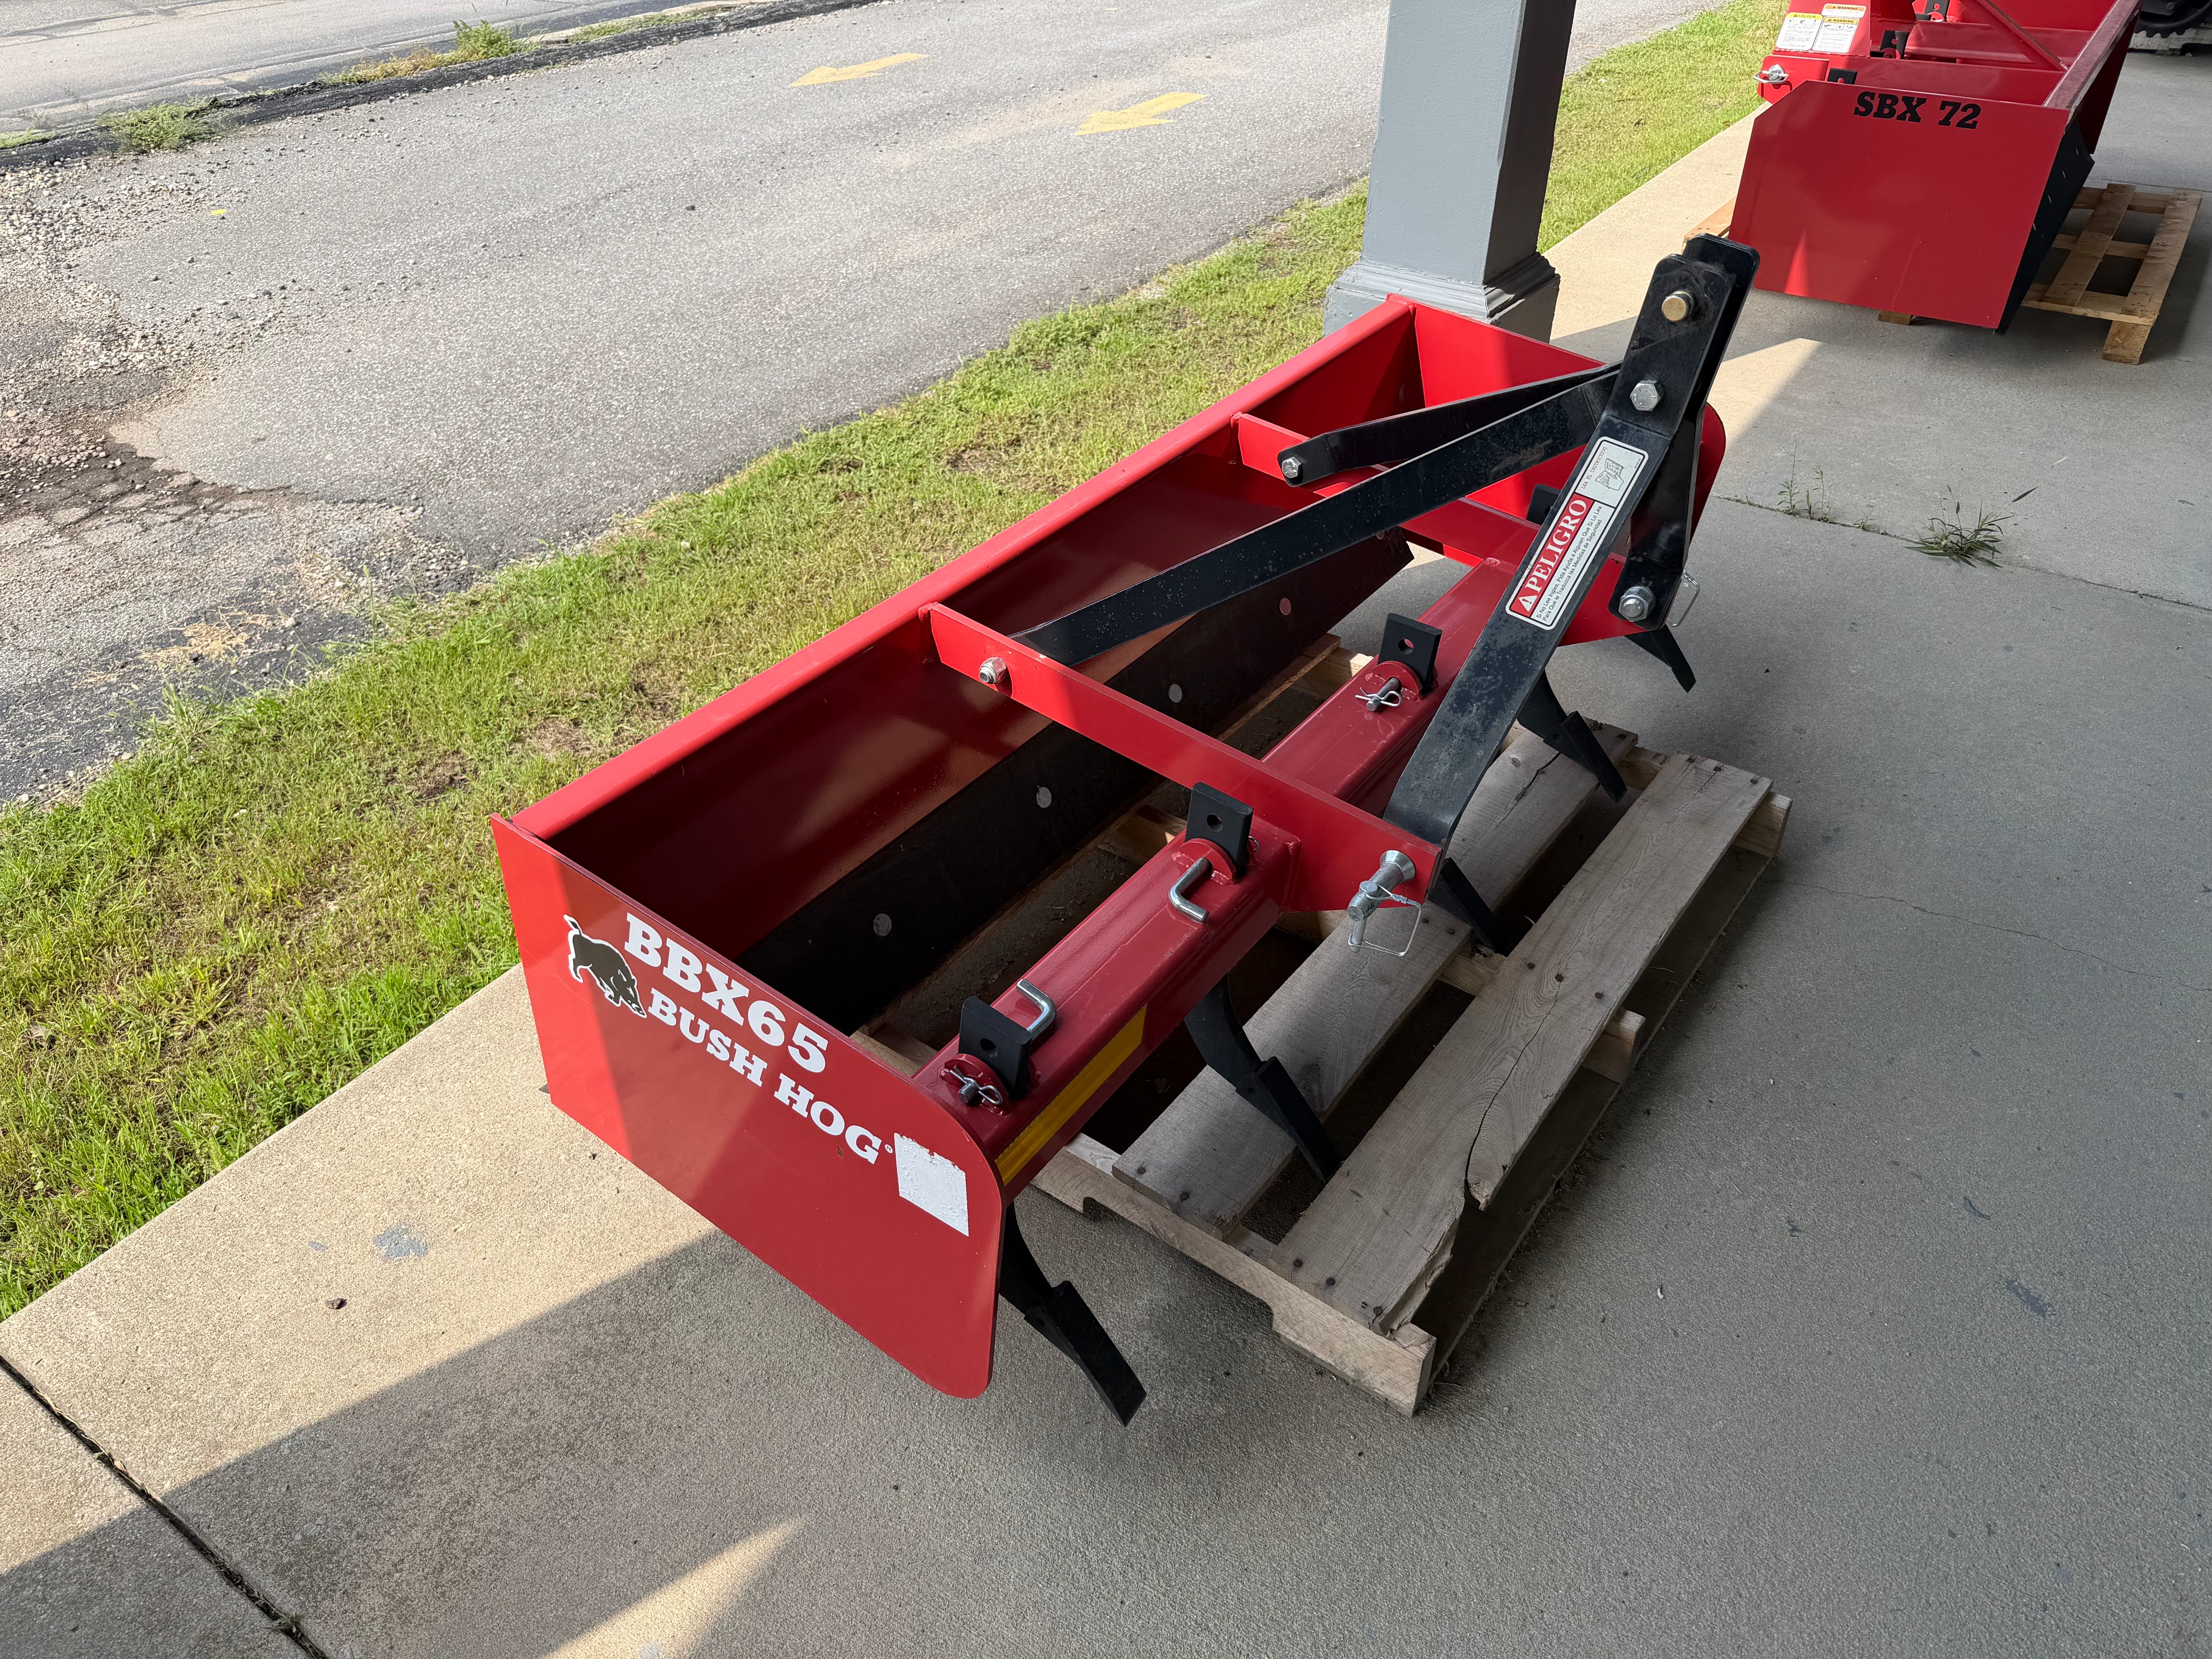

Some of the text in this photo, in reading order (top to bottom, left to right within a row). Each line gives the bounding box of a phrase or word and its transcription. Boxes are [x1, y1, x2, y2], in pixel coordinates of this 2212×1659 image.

[1853, 91, 1981, 129] SBX 72
[1525, 500, 1587, 593] PELIGRO
[1542, 611, 1551, 621] Para
[1557, 575, 1571, 595] Traduzca
[1572, 549, 1585, 568] Medidas
[1587, 519, 1602, 542] Seguridad.
[1557, 572, 1565, 582] Pida
[1563, 558, 1573, 572] Ayuda
[1573, 537, 1585, 554] Alguien
[1582, 527, 1590, 536] Que
[624, 912, 828, 1073] BBX65
[649, 987, 768, 1087] BUSH
